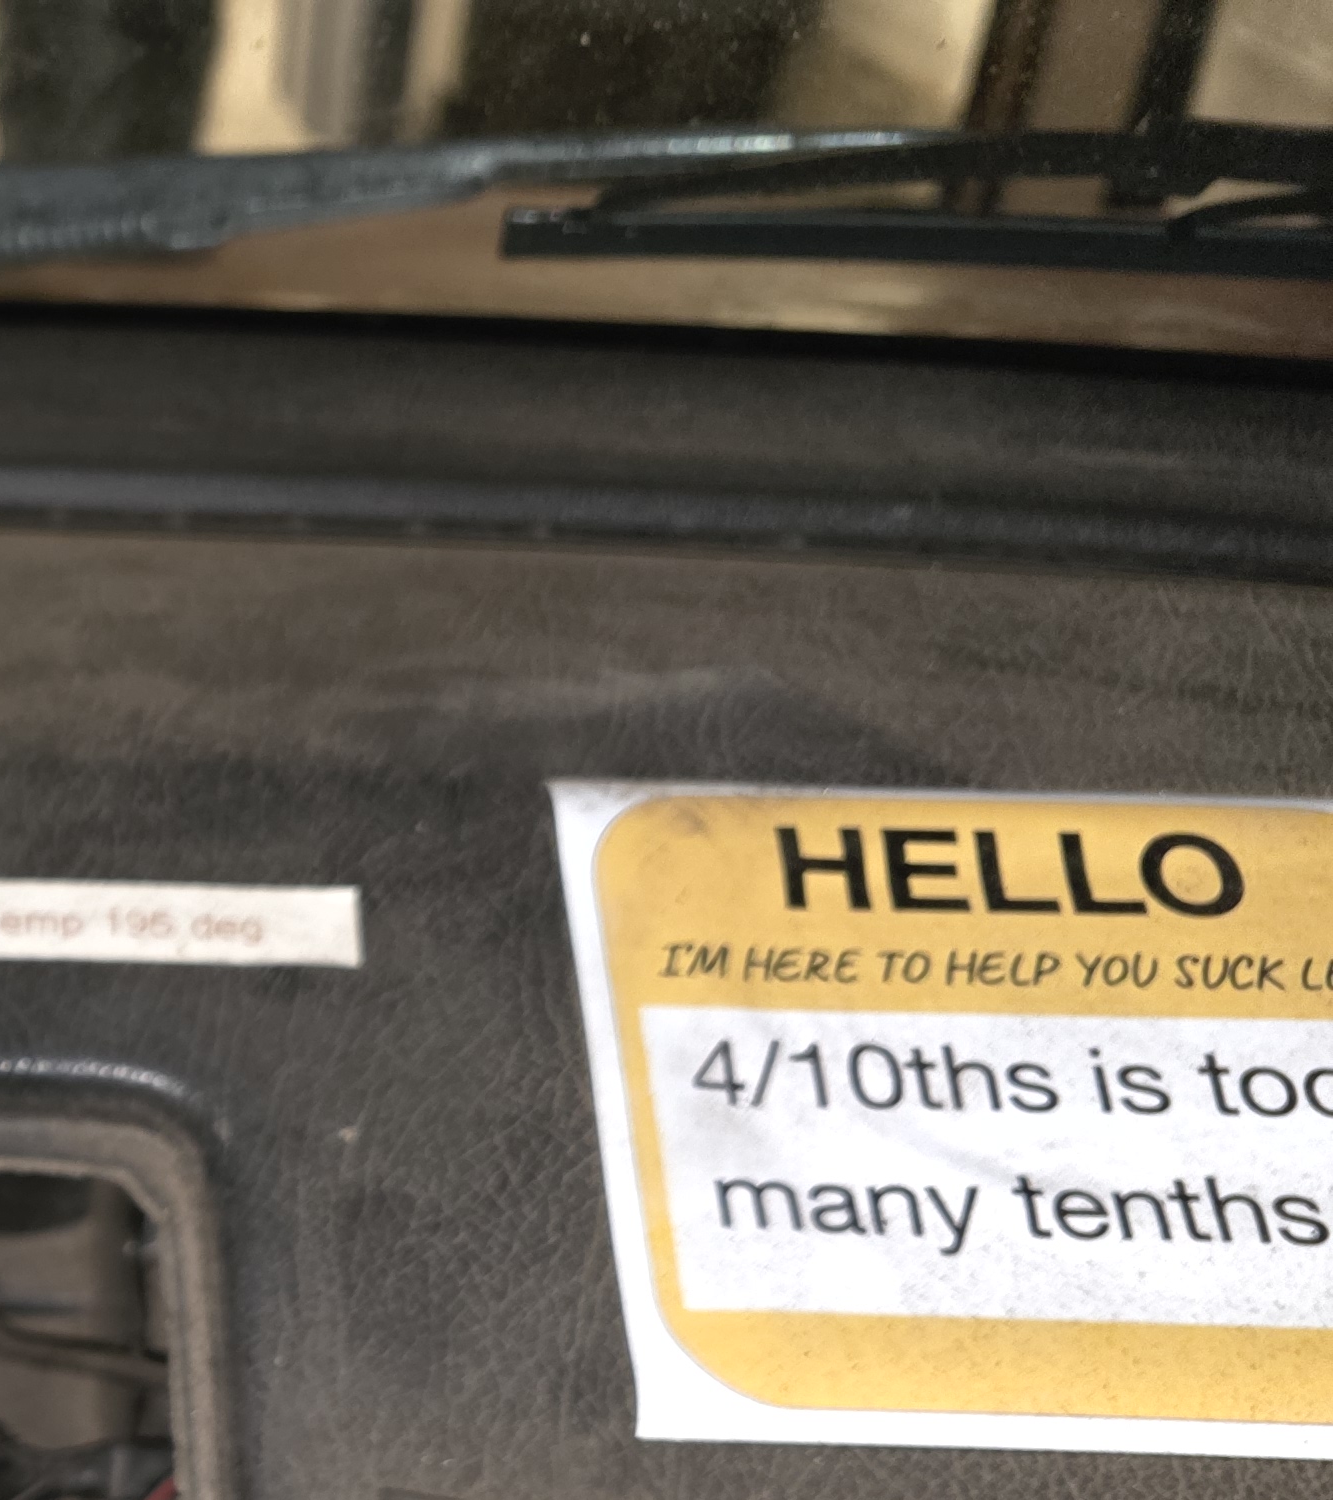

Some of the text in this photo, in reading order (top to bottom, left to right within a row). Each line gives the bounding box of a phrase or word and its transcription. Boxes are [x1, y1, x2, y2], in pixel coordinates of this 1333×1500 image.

[775, 826, 1246, 918] HELLO
[190, 911, 264, 947] deg
[659, 943, 731, 978] I'M
[744, 946, 860, 984] HERE
[878, 949, 932, 984] TO
[946, 950, 1061, 987] HELP
[1077, 951, 1158, 988] YOU
[1174, 954, 1286, 991] SUCK
[692, 1038, 1060, 1114] 4/10ths
[1092, 1048, 1171, 1116] is
[714, 1174, 1330, 1257] many tenths
